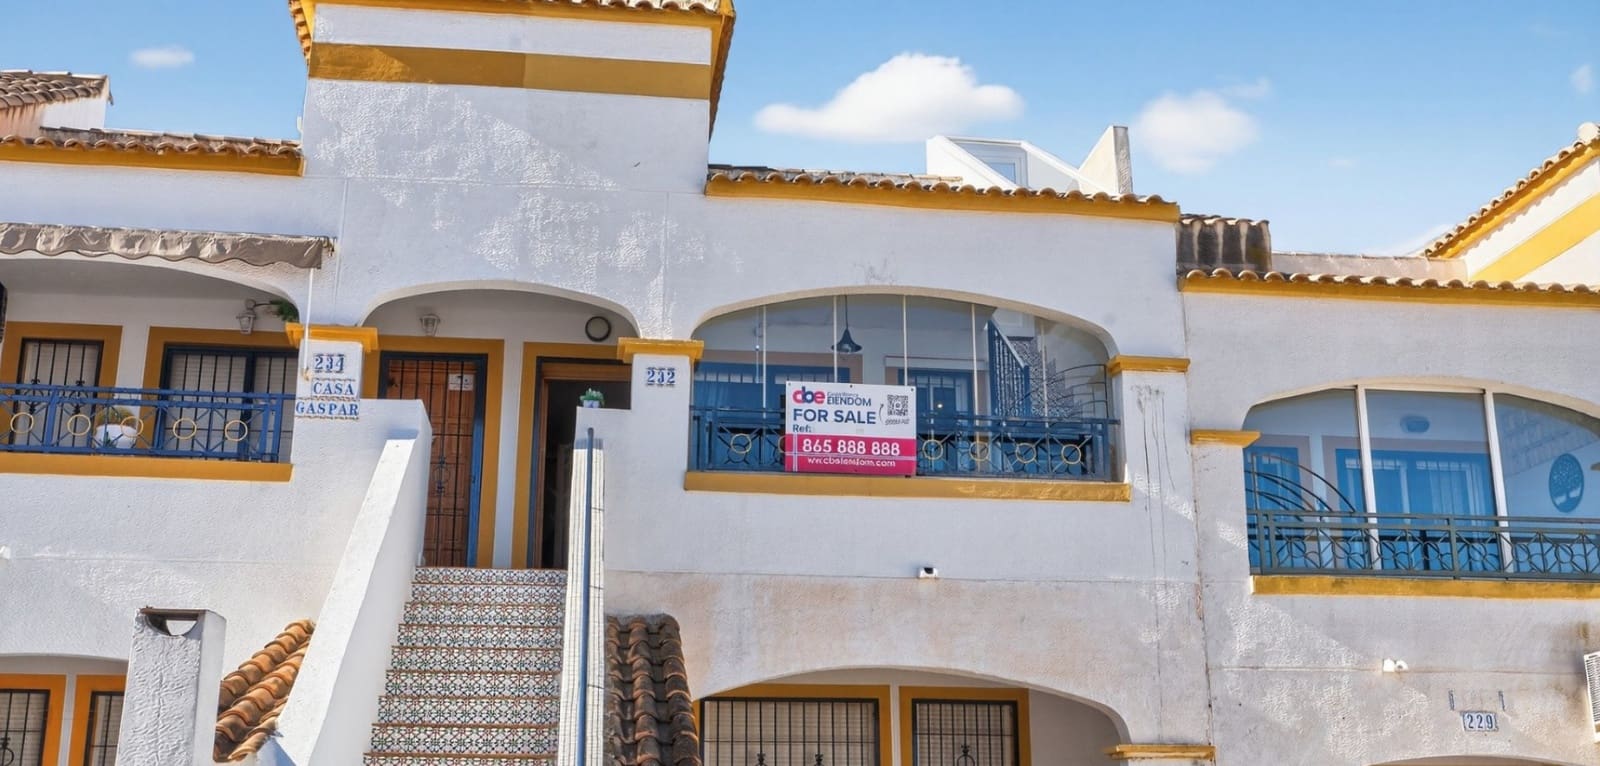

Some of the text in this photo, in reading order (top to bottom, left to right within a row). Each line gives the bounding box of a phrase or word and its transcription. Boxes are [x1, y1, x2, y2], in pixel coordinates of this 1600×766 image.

[315, 356, 345, 371] 234
[647, 370, 676, 384] 232
[313, 382, 354, 395] CASA
[295, 401, 360, 416] GASPAR
[826, 396, 872, 407] EIENDOM
[793, 408, 829, 422] FOR
[833, 410, 877, 425] SALE
[802, 438, 900, 456] 865 888 888
[1466, 713, 1494, 729] 229
